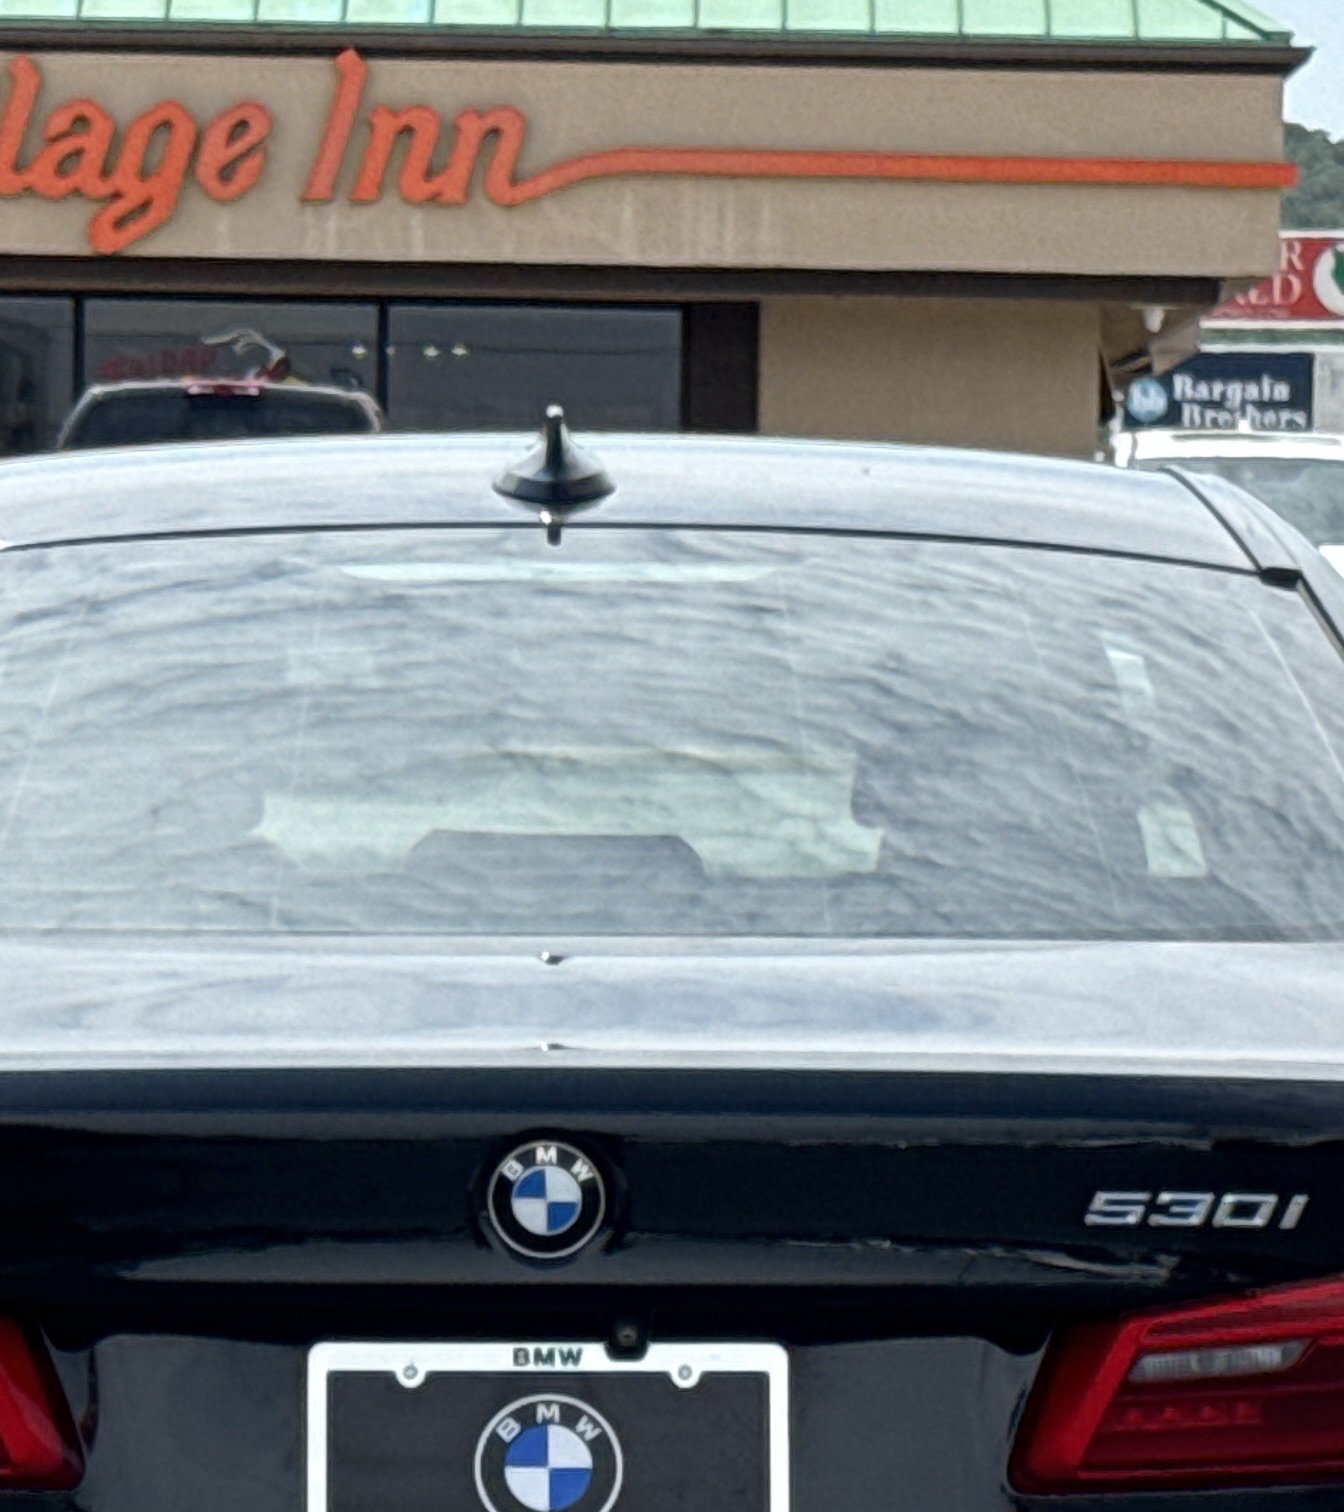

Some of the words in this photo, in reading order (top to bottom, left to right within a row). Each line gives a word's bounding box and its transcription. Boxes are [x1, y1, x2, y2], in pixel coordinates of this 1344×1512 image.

[303, 48, 528, 206] Inn
[1172, 373, 1292, 411] Bargain
[501, 1145, 594, 1183] BMW
[513, 1347, 583, 1367] BMW
[496, 1403, 603, 1443] BMW
